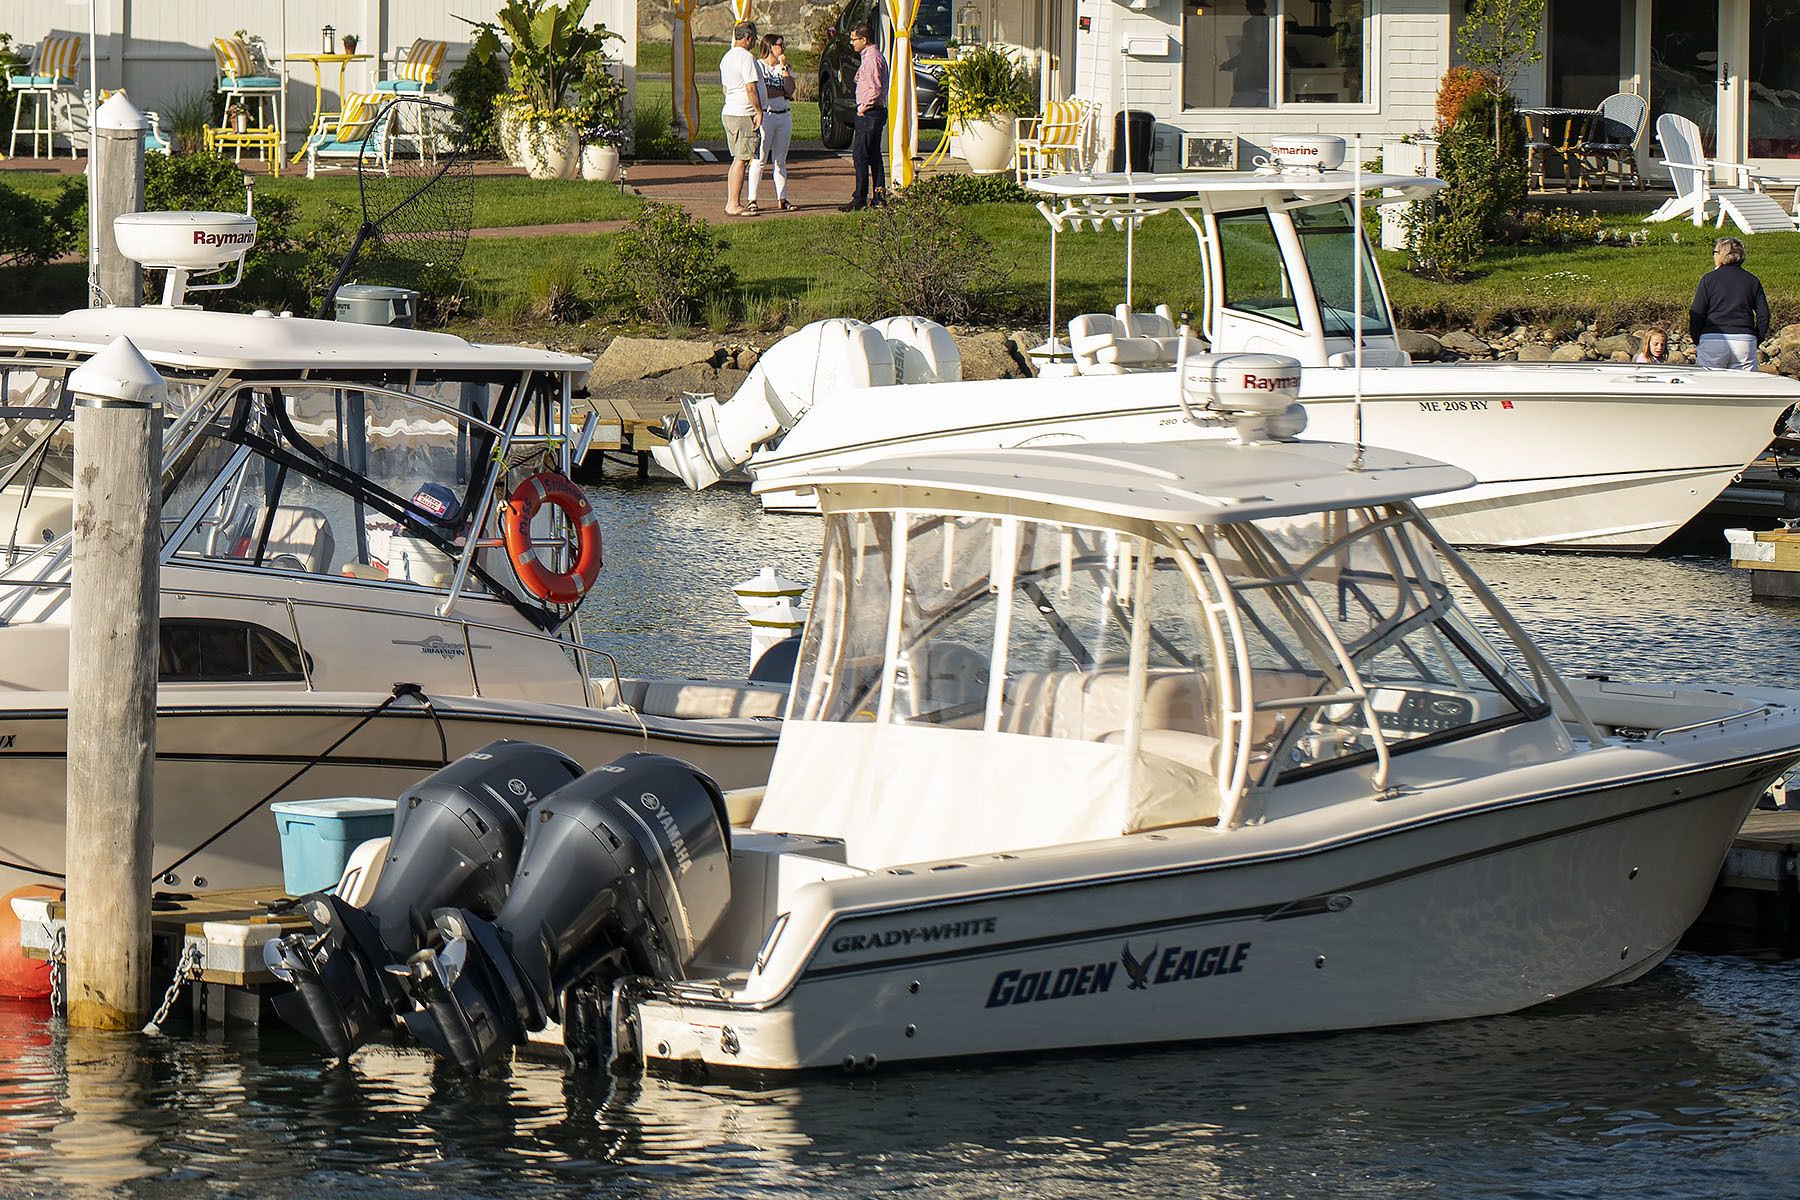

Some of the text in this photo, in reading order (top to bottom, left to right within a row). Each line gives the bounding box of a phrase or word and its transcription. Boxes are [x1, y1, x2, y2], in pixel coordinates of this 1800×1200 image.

[1419, 400, 1488, 412] ME 208 RY
[656, 805, 694, 875] YAMAHA
[831, 916, 997, 955] GRADY-WHITE
[984, 942, 1252, 1009] GOLDEN EAGLE
